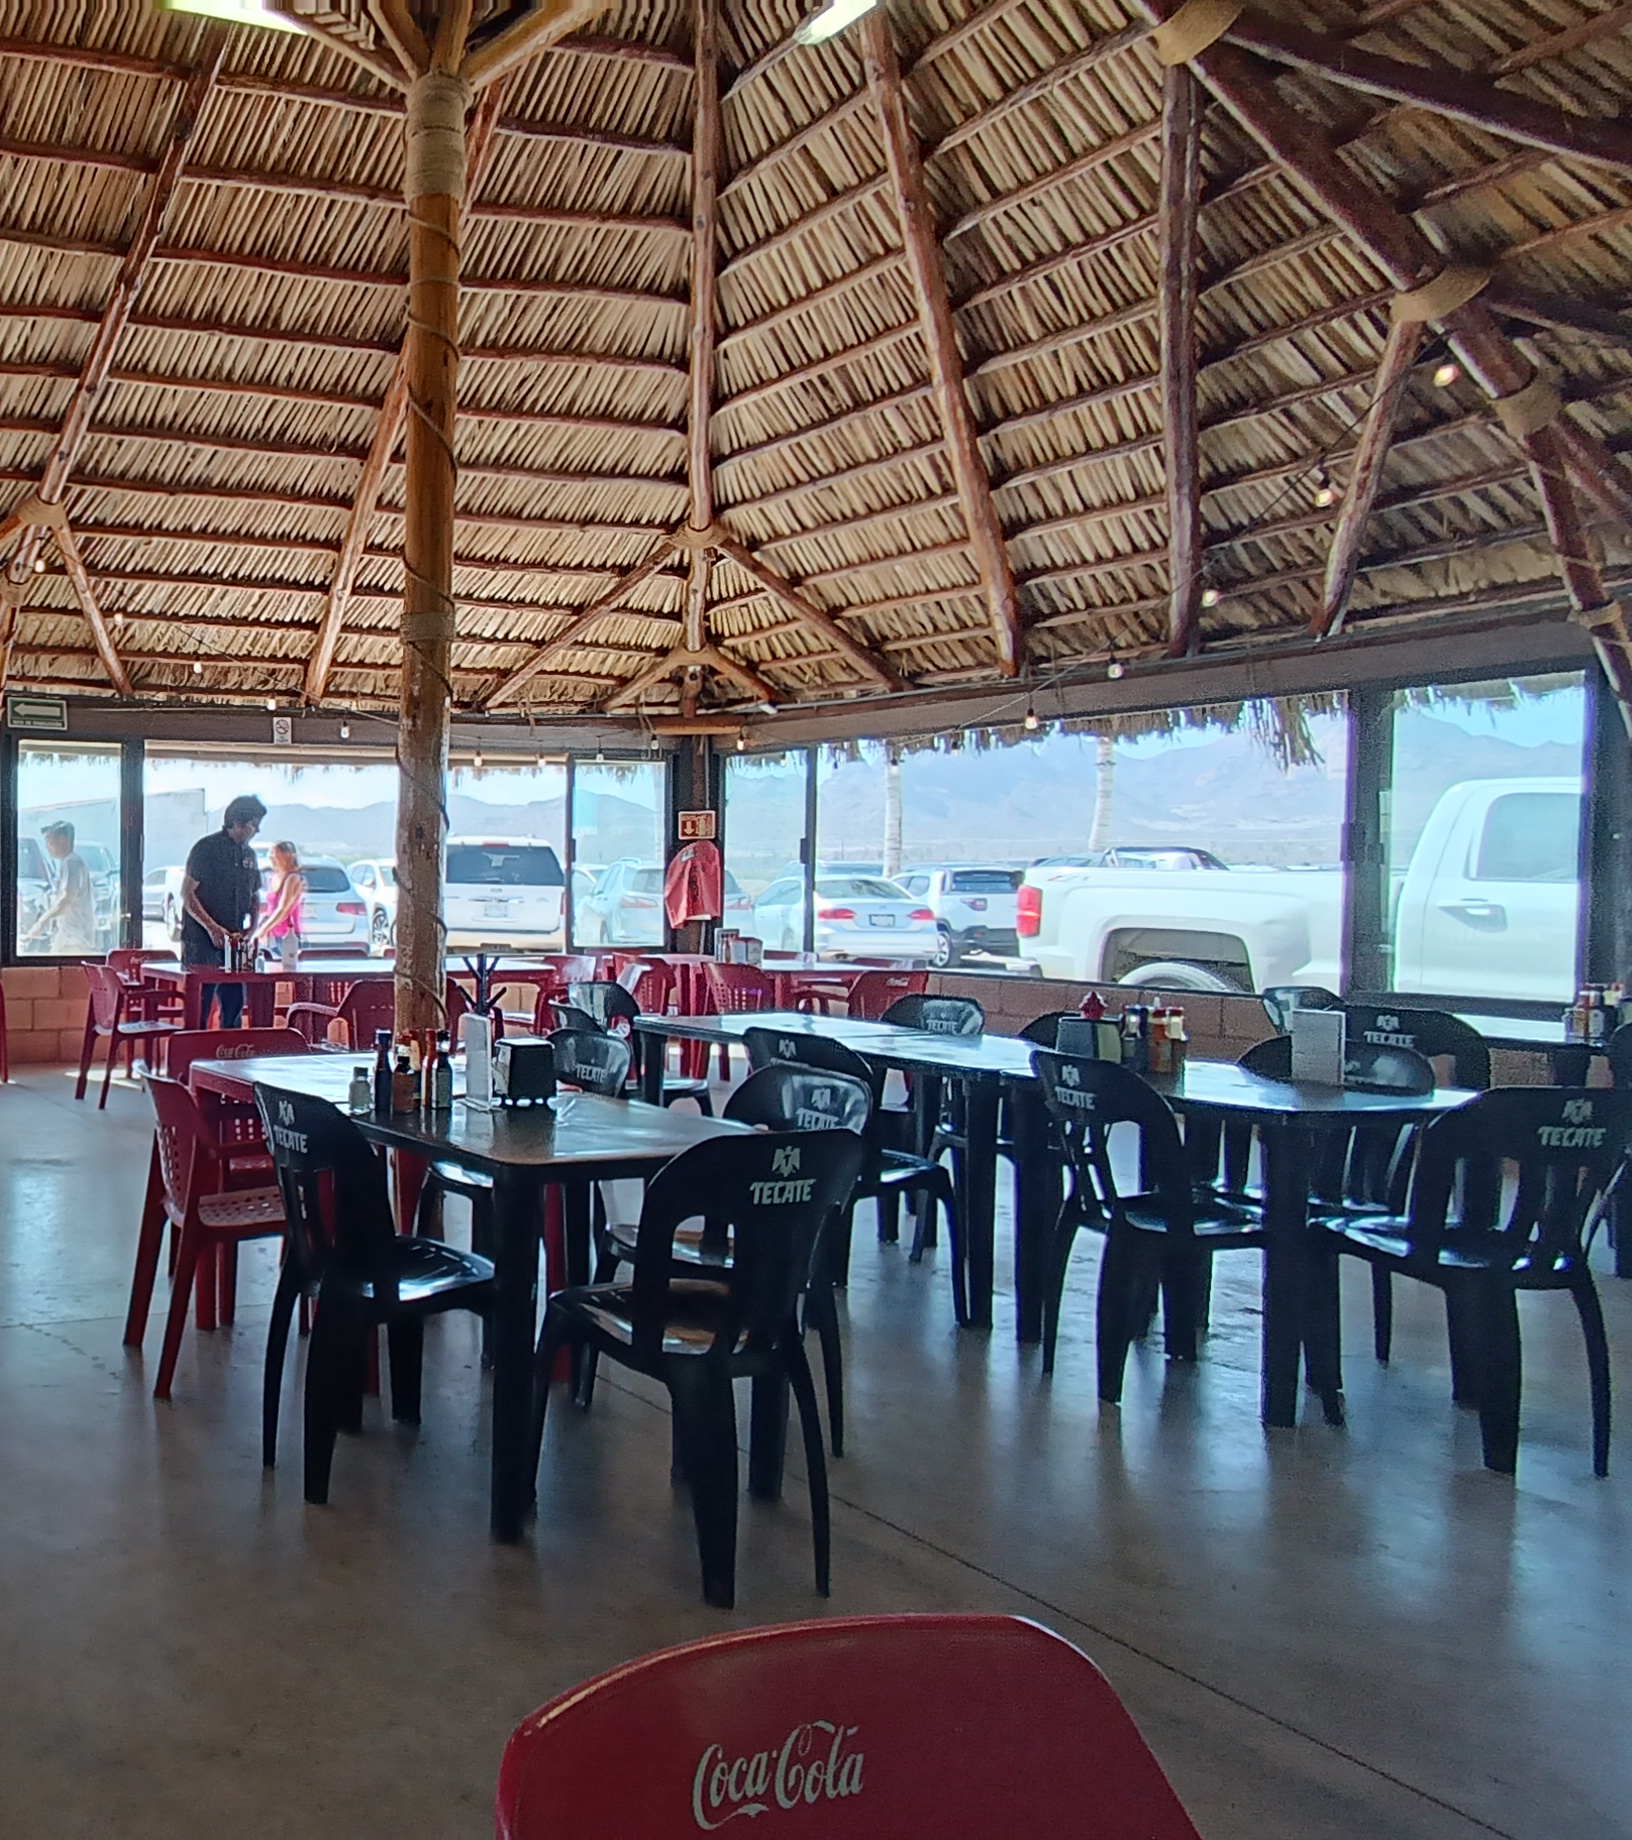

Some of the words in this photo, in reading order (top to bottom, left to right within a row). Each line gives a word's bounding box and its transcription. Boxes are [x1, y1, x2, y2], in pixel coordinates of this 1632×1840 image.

[1363, 1031, 1415, 1048] TECATE
[1054, 1085, 1096, 1110] TECATE
[273, 1124, 308, 1153] TECATE
[1536, 1126, 1607, 1148] TECATE
[749, 1178, 816, 1205] TECATE
